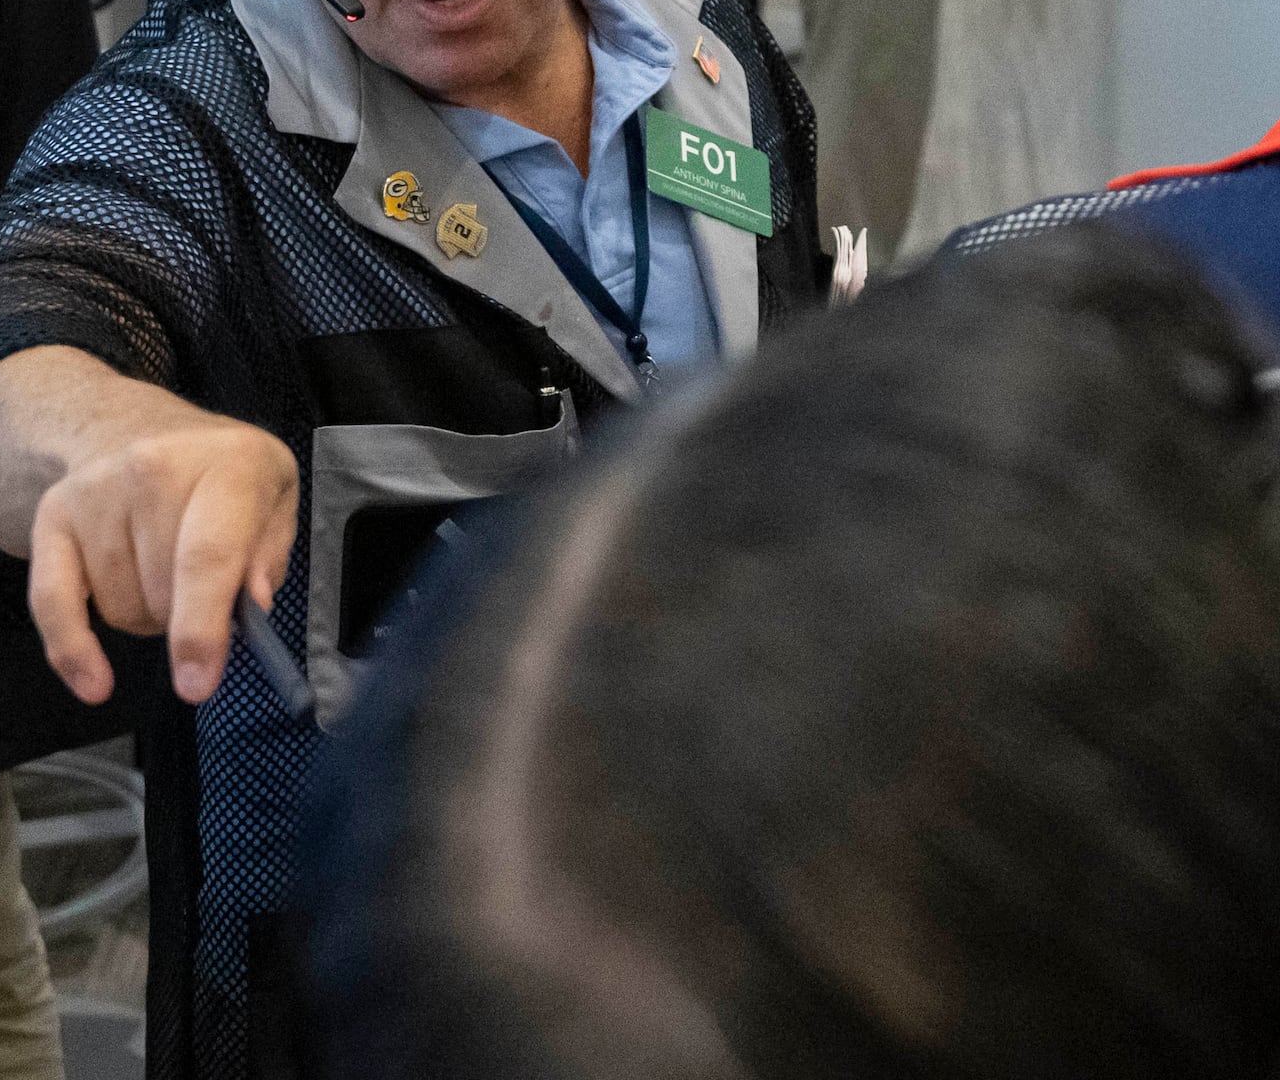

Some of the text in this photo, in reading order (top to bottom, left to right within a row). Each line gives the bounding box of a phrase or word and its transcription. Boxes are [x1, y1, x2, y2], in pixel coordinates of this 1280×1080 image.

[680, 130, 737, 182] F01
[387, 179, 408, 197] G
[673, 166, 748, 204] ANTHONY SPINA
[454, 223, 472, 240] 2
